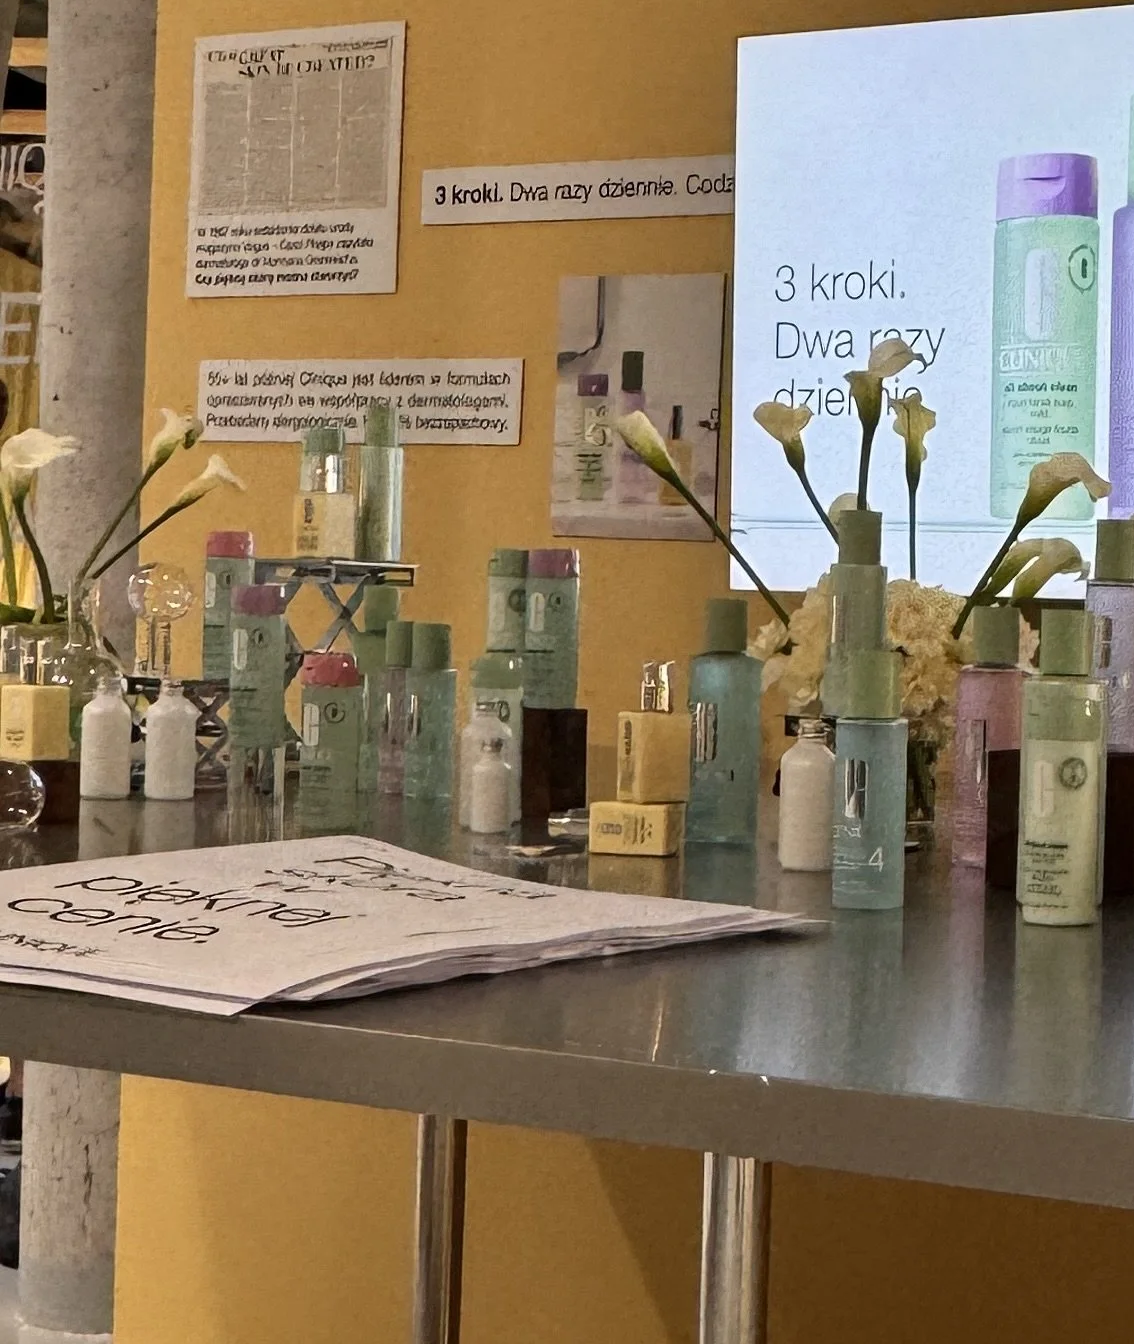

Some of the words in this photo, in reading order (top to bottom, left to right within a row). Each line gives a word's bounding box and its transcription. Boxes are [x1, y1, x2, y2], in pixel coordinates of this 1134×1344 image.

[435, 186, 447, 205] 3
[451, 182, 504, 205] kroki.
[510, 182, 548, 202] Dwa
[554, 183, 592, 204] razy
[599, 175, 677, 198] dziennie.
[775, 264, 796, 302] 3
[811, 258, 906, 301] kroki.
[776, 322, 855, 359] Dwa
[773, 378, 922, 416] dzieni
[869, 846, 884, 873] 4
[7, 898, 220, 944] cenie.
